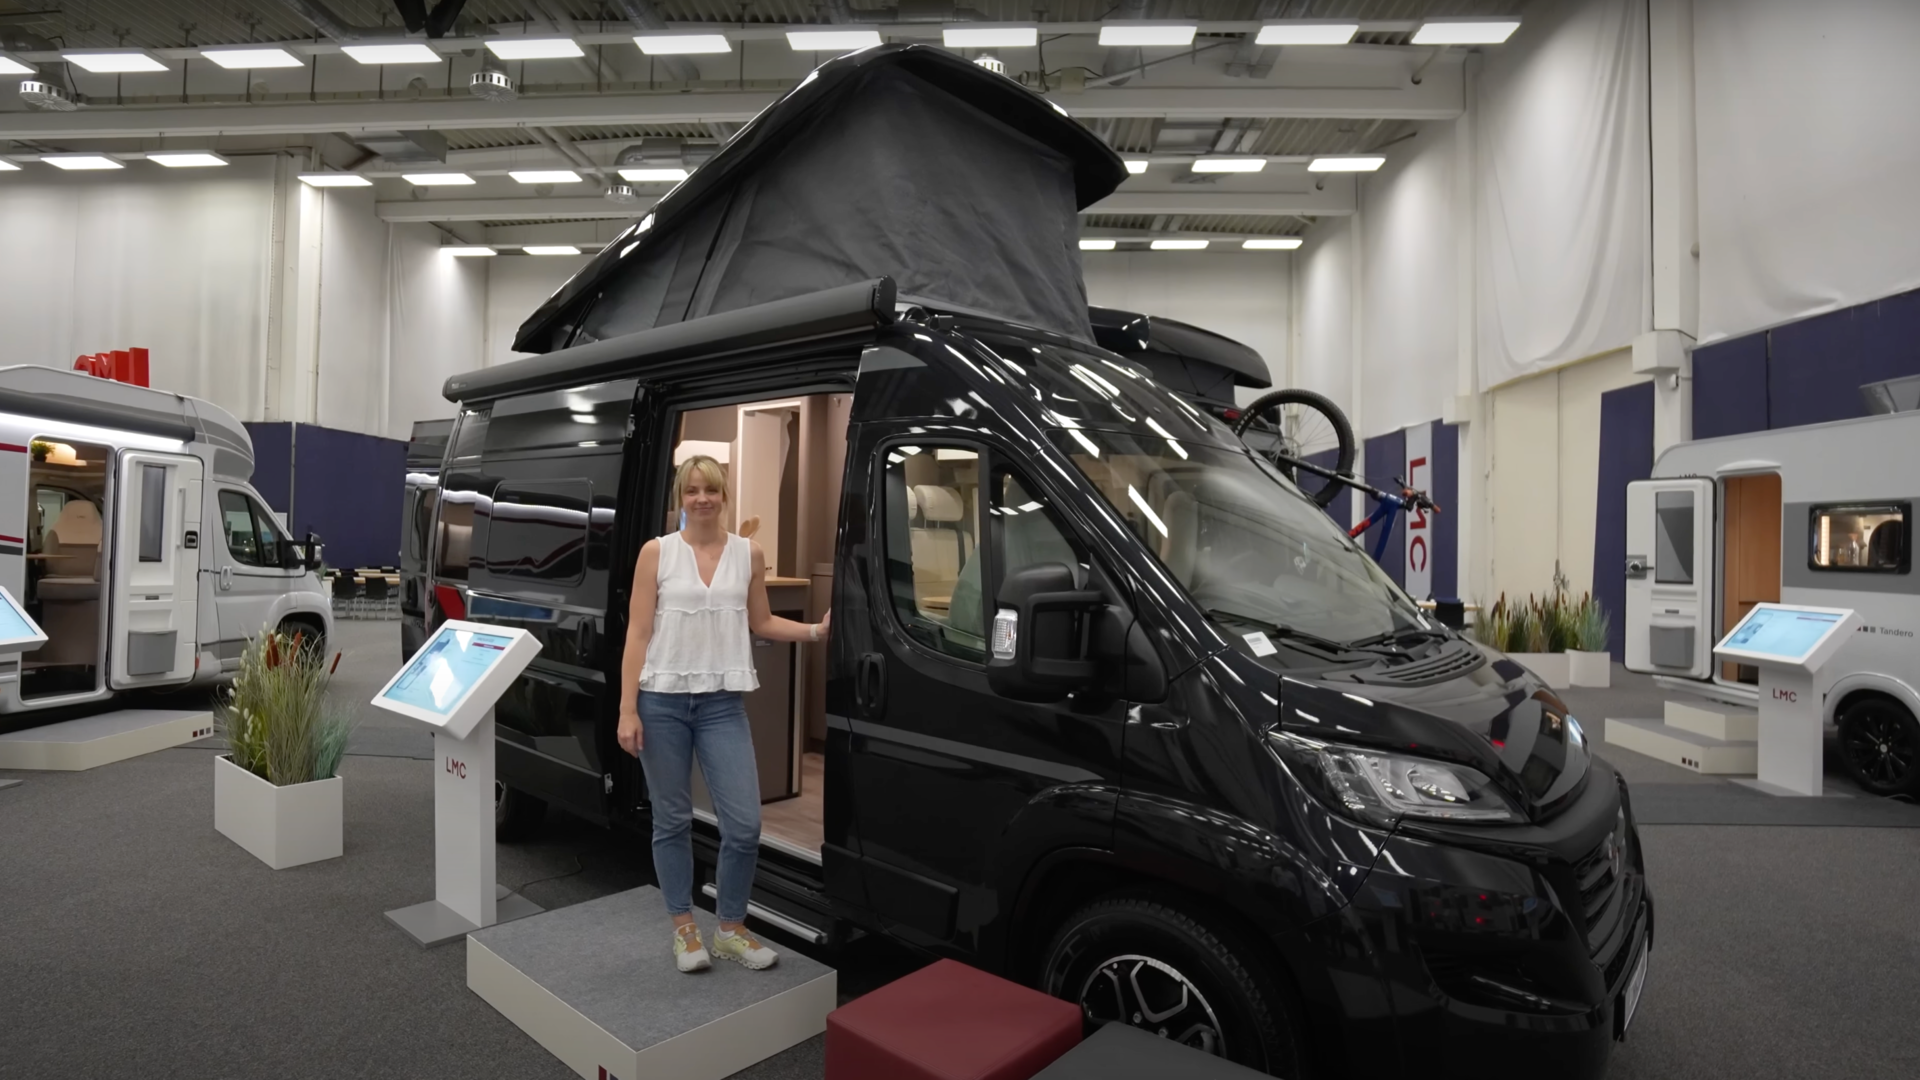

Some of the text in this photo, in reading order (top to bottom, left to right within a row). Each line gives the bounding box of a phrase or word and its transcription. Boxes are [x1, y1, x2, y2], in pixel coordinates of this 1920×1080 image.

[1880, 627, 1914, 638] Tandero
[1772, 687, 1797, 703] LMC
[446, 756, 466, 779] LMC
